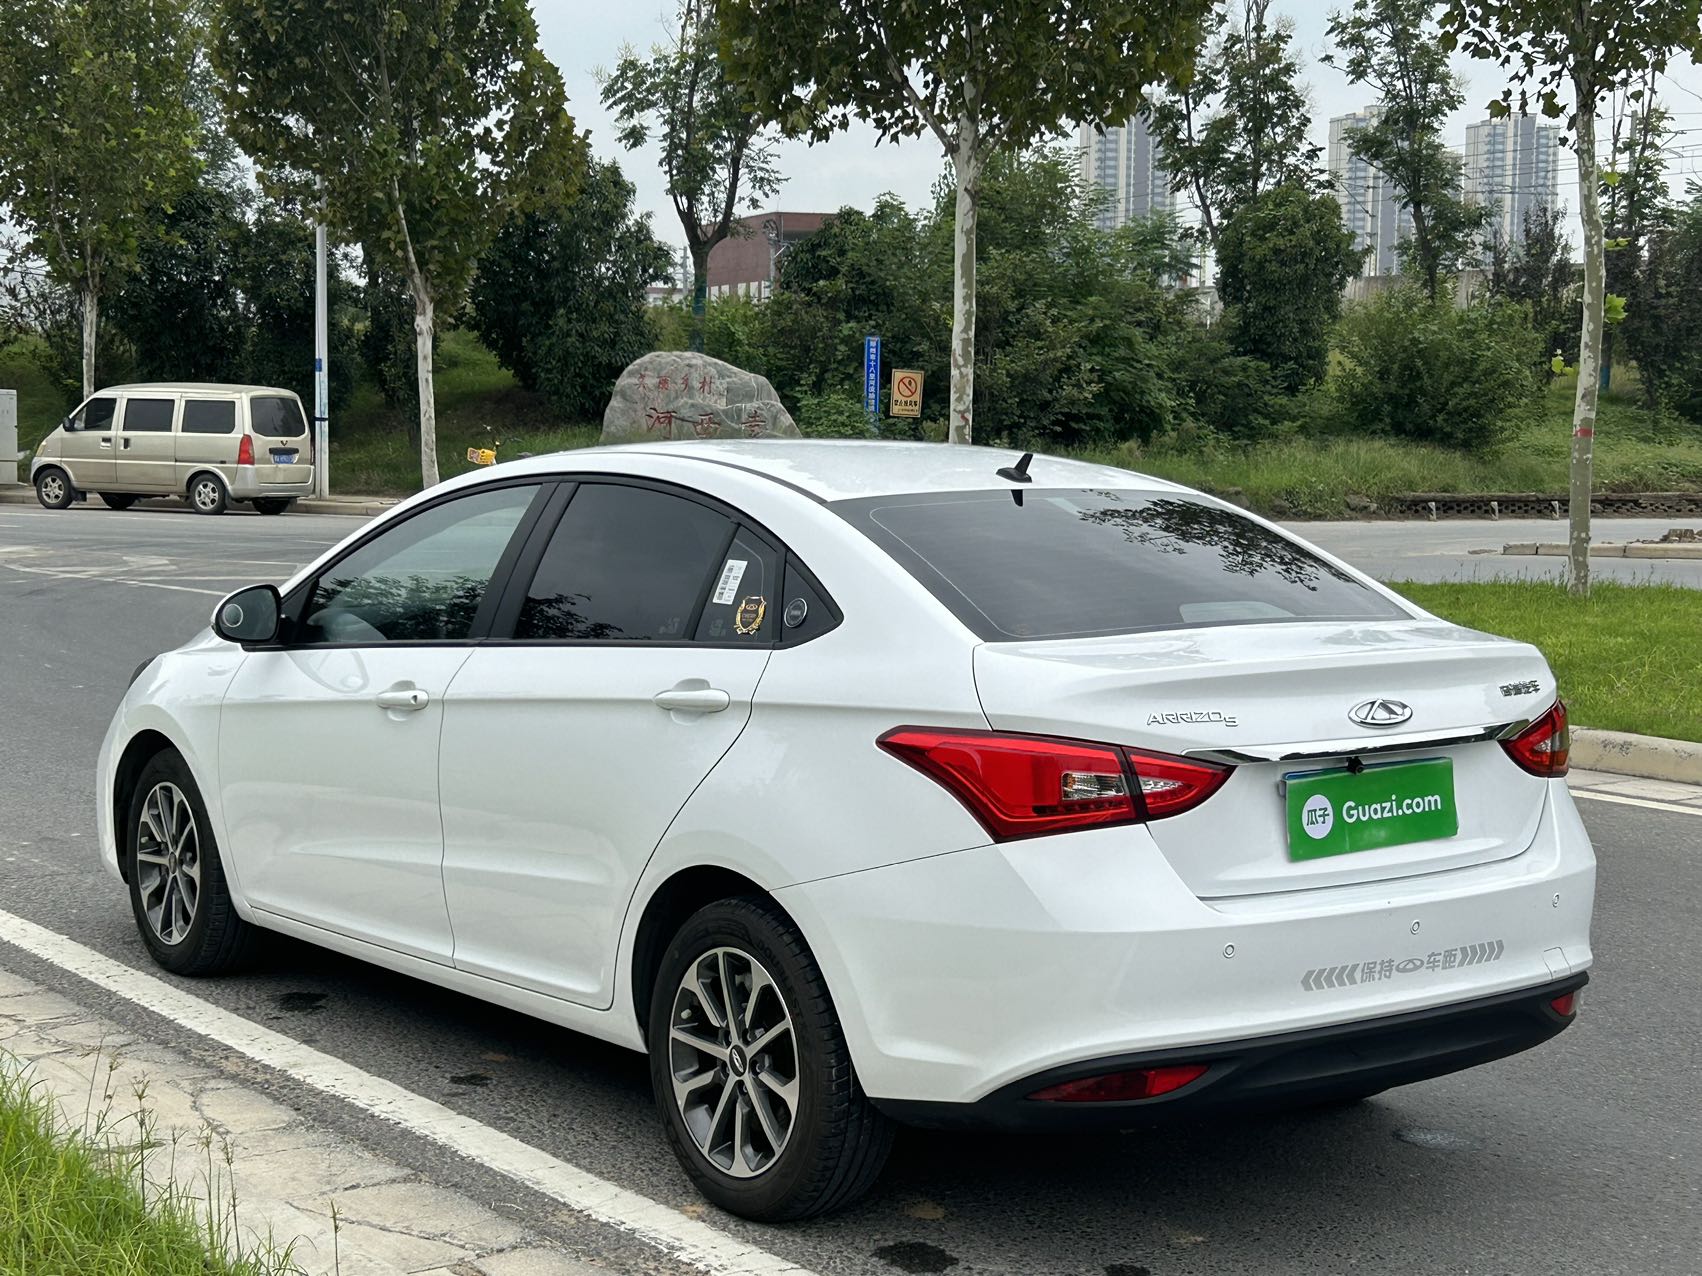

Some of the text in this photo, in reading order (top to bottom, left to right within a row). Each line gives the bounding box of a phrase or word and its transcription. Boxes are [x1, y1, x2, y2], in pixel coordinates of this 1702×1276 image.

[1306, 807, 1330, 826] 瓜子
[1342, 794, 1442, 824] Guazi.com
[1360, 948, 1458, 984] 保持 车距
